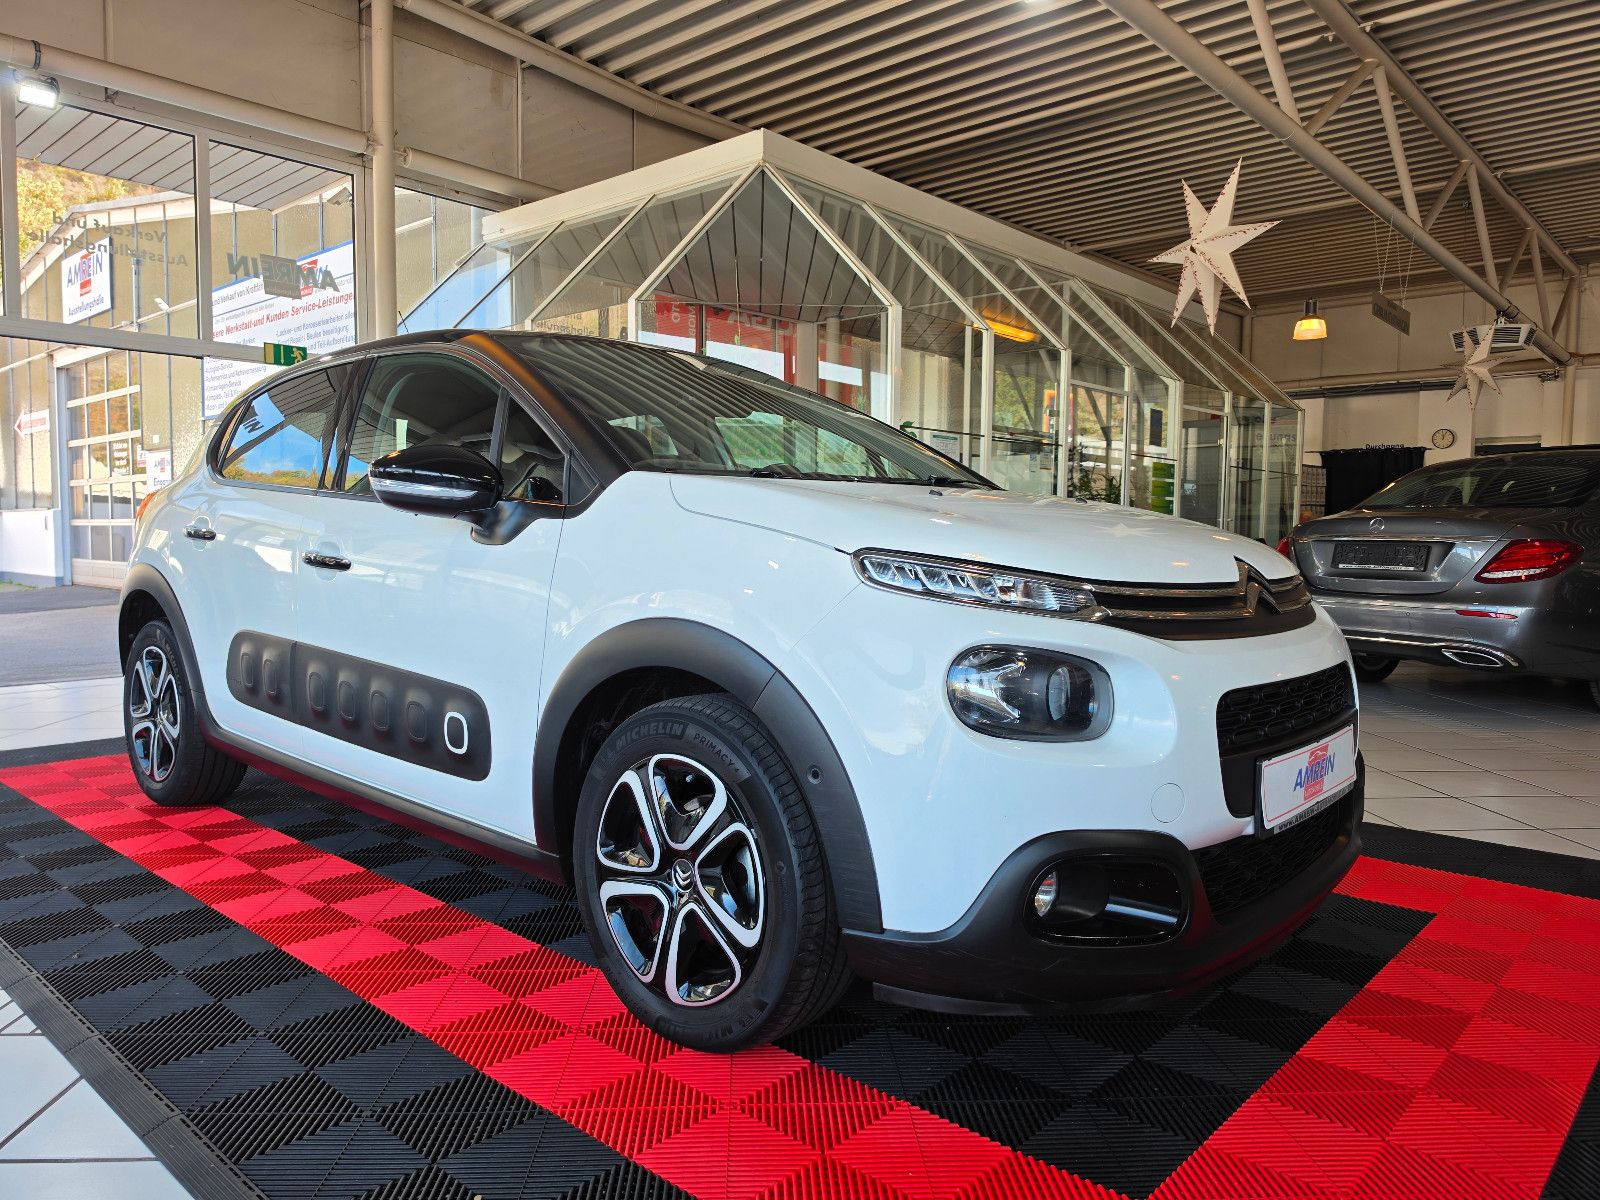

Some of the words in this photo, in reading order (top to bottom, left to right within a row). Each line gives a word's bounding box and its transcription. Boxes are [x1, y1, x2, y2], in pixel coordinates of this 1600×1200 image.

[66, 252, 104, 288] AMREIN
[213, 329, 225, 339] sere
[266, 309, 290, 323] Kunden
[291, 292, 354, 316] Service-Leistunge
[317, 334, 356, 349] Teil-Aufbereitun
[615, 721, 685, 751] MICHELIN
[693, 732, 735, 768] PRIMACY
[1293, 751, 1336, 793] AMREIN
